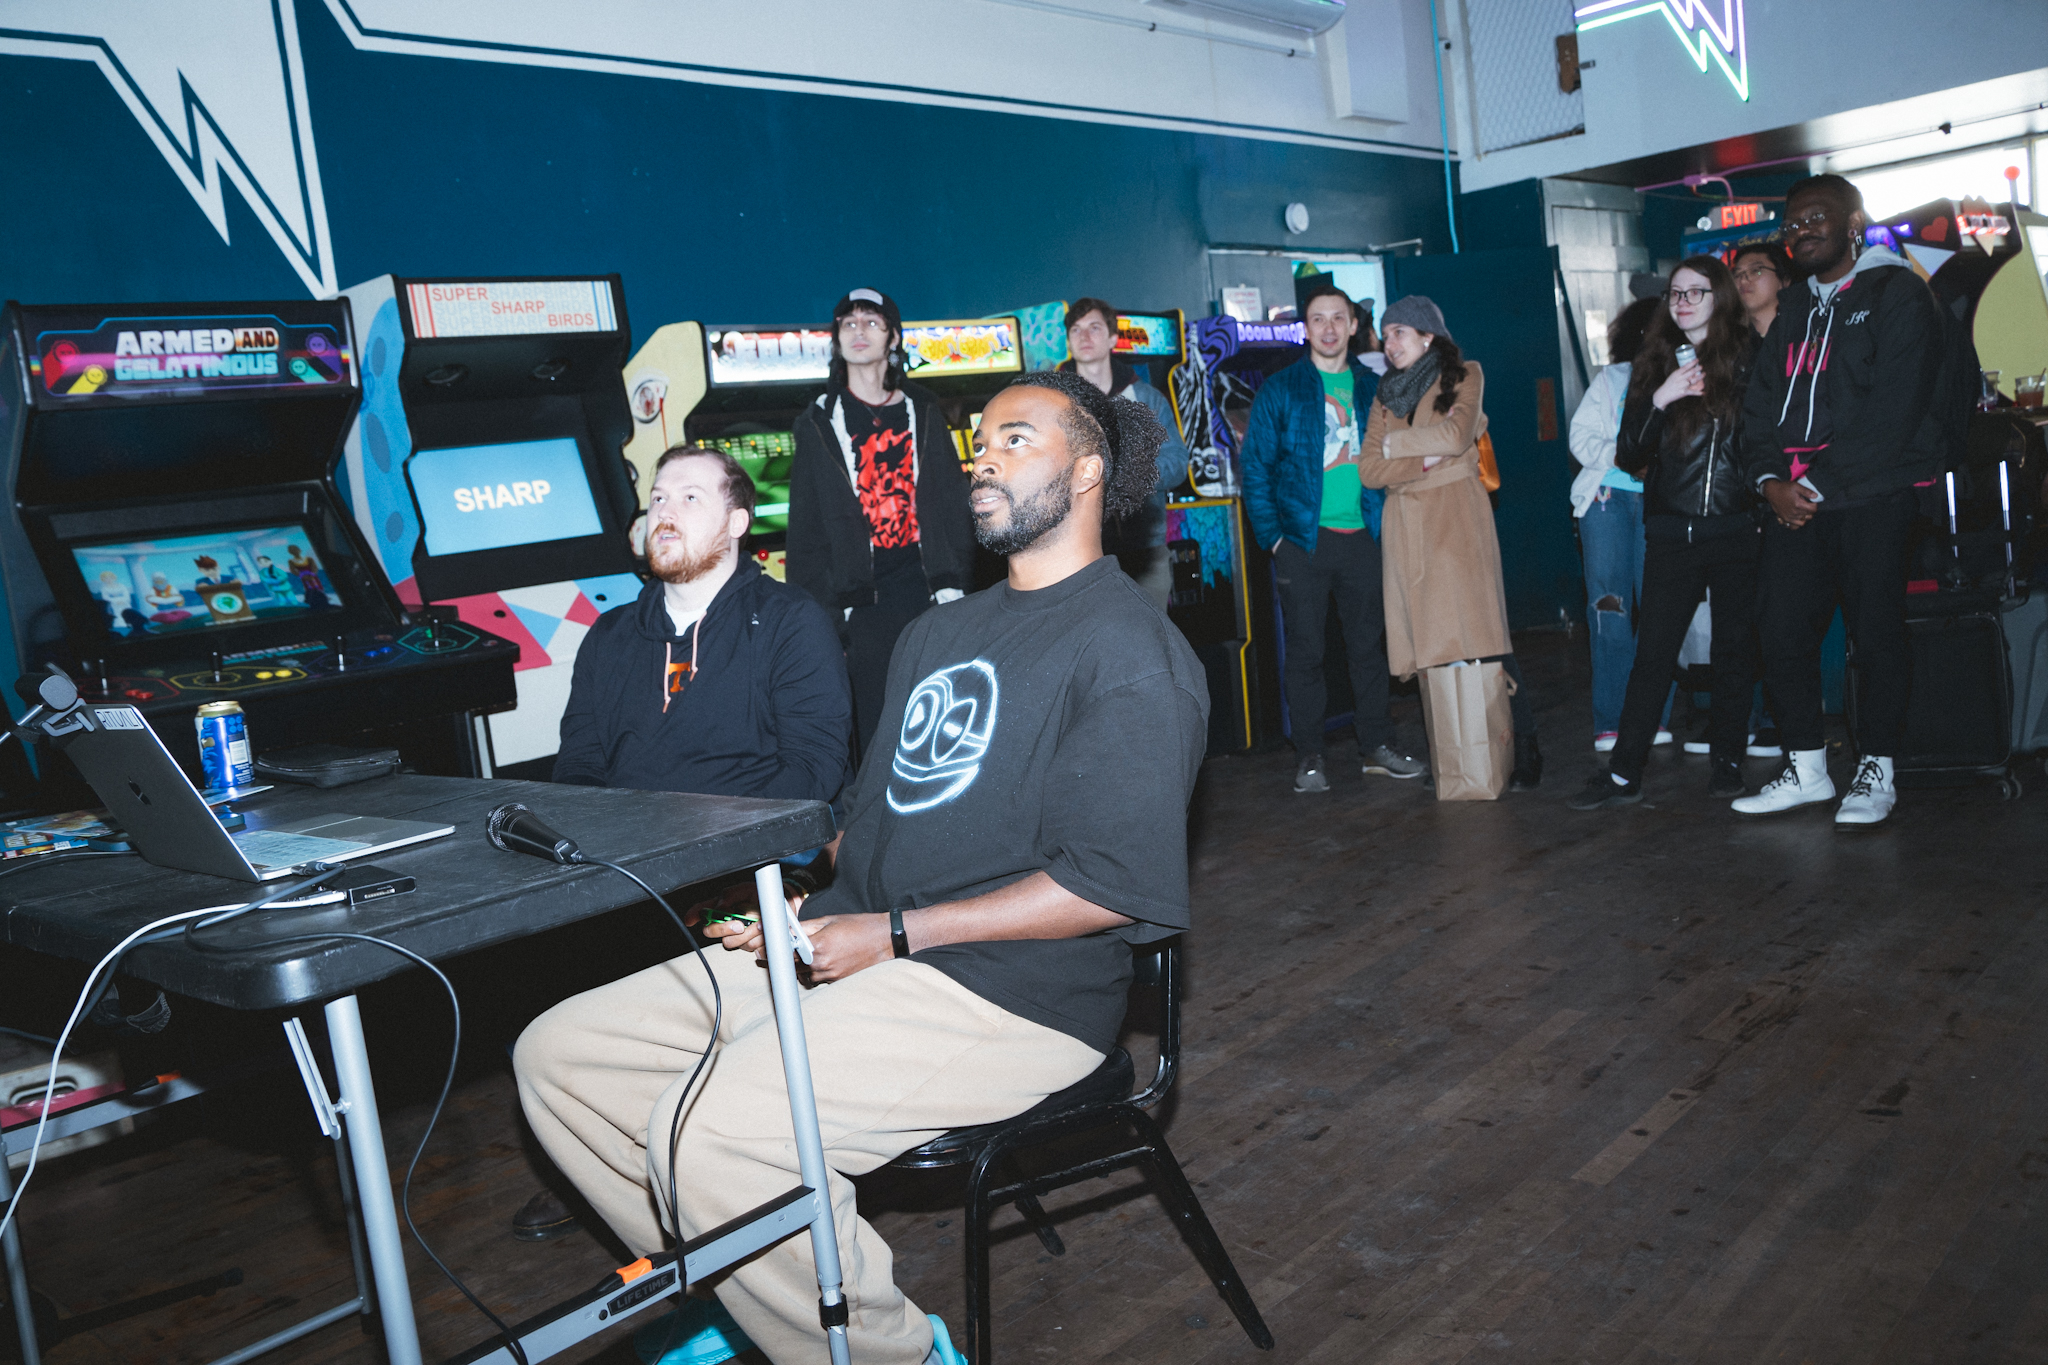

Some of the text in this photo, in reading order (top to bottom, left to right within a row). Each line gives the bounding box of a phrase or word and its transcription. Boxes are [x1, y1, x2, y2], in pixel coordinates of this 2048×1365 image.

[1721, 203, 1758, 229] EXIT
[432, 287, 489, 302] SUPER
[491, 300, 545, 315] SHARP
[548, 313, 595, 327] BIRDS
[1236, 321, 1306, 345] DOOM DROP
[115, 328, 278, 356] ARMED AND
[114, 352, 279, 381] GELATINOUS
[453, 479, 551, 512] SHARP
[616, 1275, 669, 1309] LIFETIME
